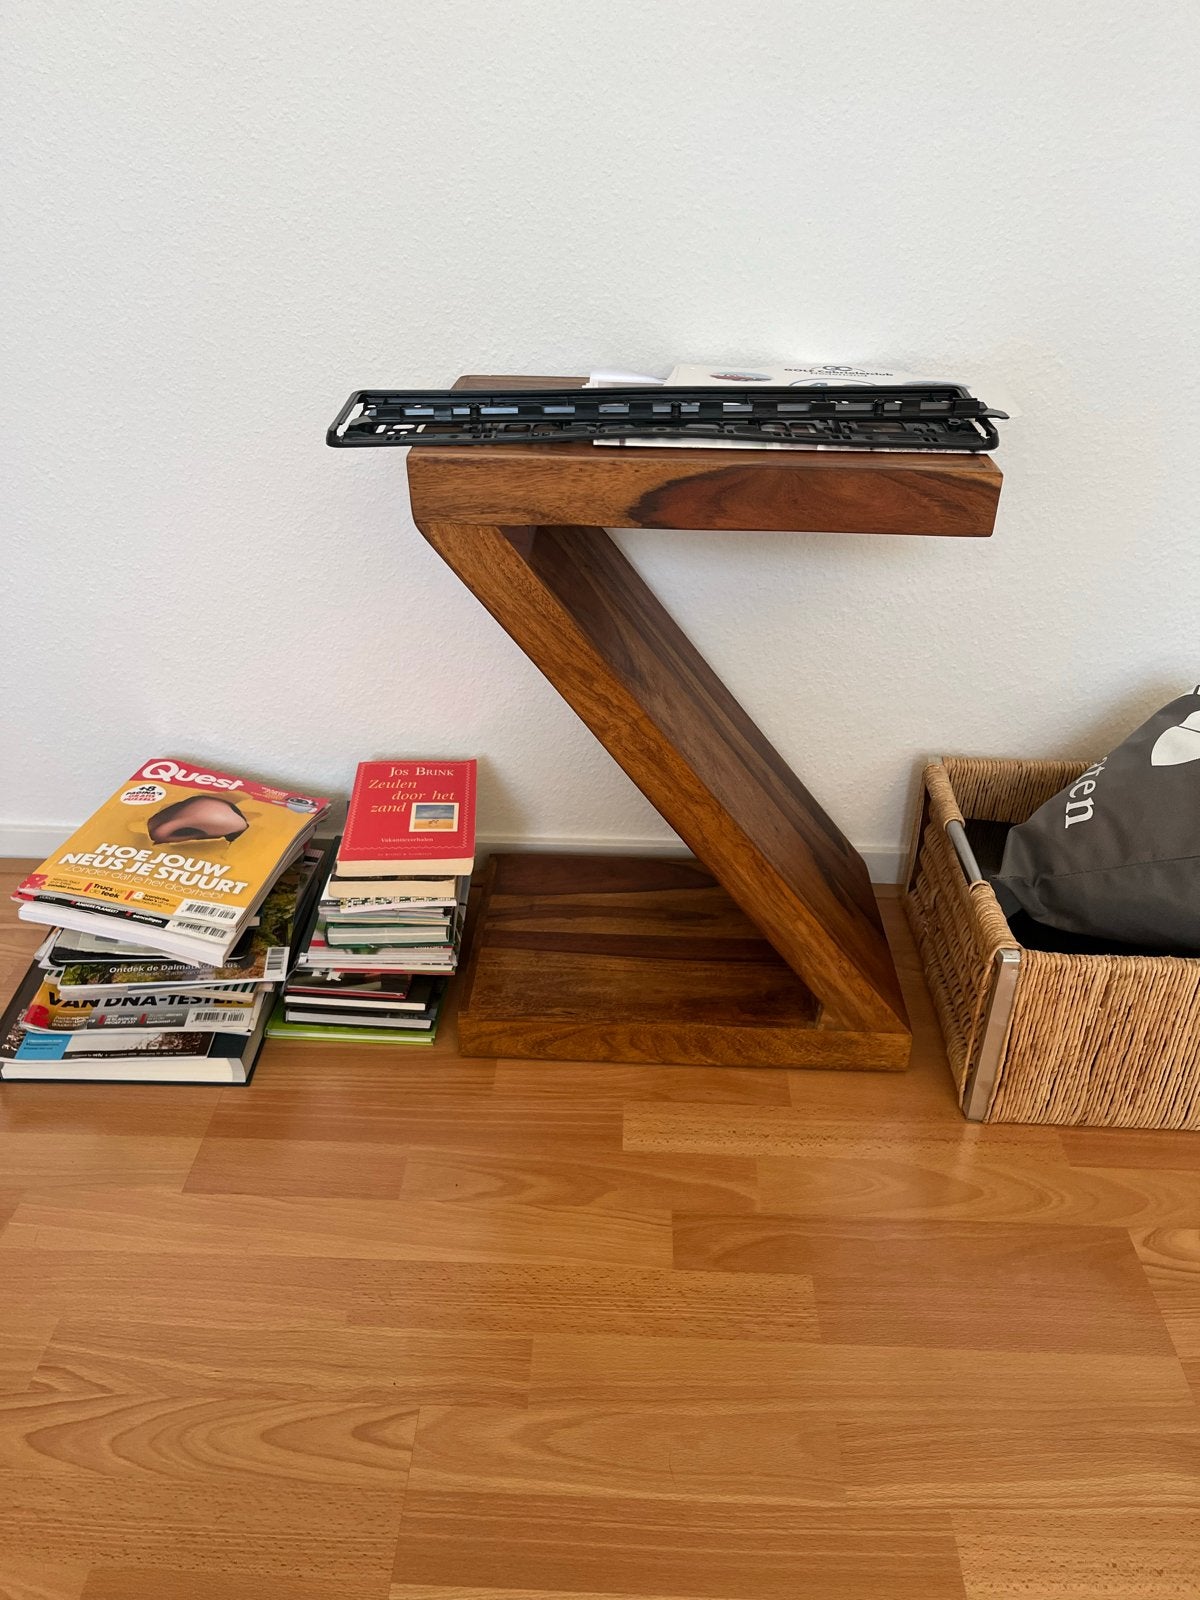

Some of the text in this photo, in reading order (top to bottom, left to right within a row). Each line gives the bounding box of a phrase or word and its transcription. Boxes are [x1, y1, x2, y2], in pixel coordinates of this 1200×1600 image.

[142, 761, 245, 790] Quest
[368, 779, 417, 789] Zeulen
[392, 790, 455, 800] door het
[370, 803, 406, 813] zand
[95, 843, 231, 877] HOE JOUW
[58, 853, 248, 895] NEUS JE STUURT
[65, 865, 110, 877] Zonder
[111, 869, 129, 881] dat
[128, 872, 142, 883] je
[144, 874, 165, 888] het
[93, 883, 115, 892] Trucs
[109, 964, 145, 974] Ontdek
[146, 963, 158, 971] de
[48, 992, 101, 1008] VAN
